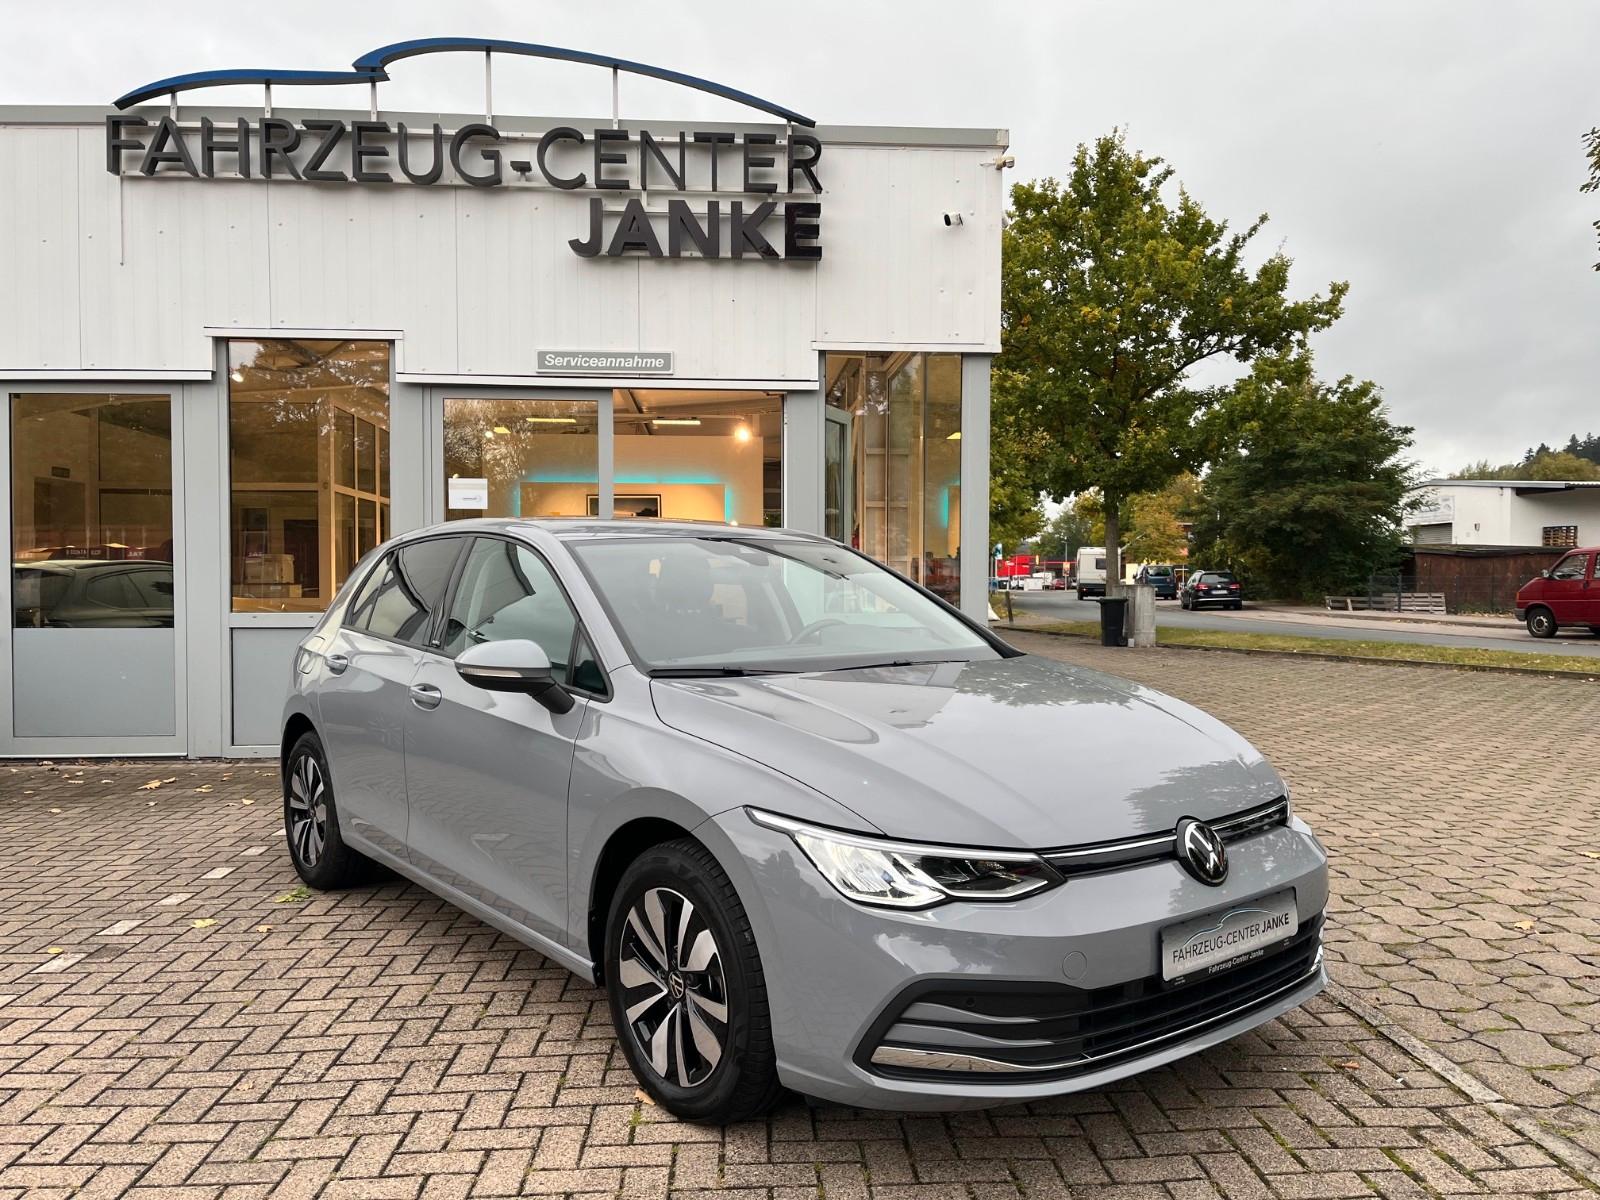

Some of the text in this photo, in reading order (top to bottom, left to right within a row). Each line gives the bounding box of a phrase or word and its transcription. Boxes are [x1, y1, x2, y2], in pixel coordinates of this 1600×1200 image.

[106, 114, 822, 195] FAHRZEUG-CENTER
[568, 197, 822, 262] JANKE
[544, 354, 665, 368] Serviceannahme
[1172, 926, 1261, 964] FAHRZEUG-CENTER
[1261, 912, 1290, 934] JANKE
